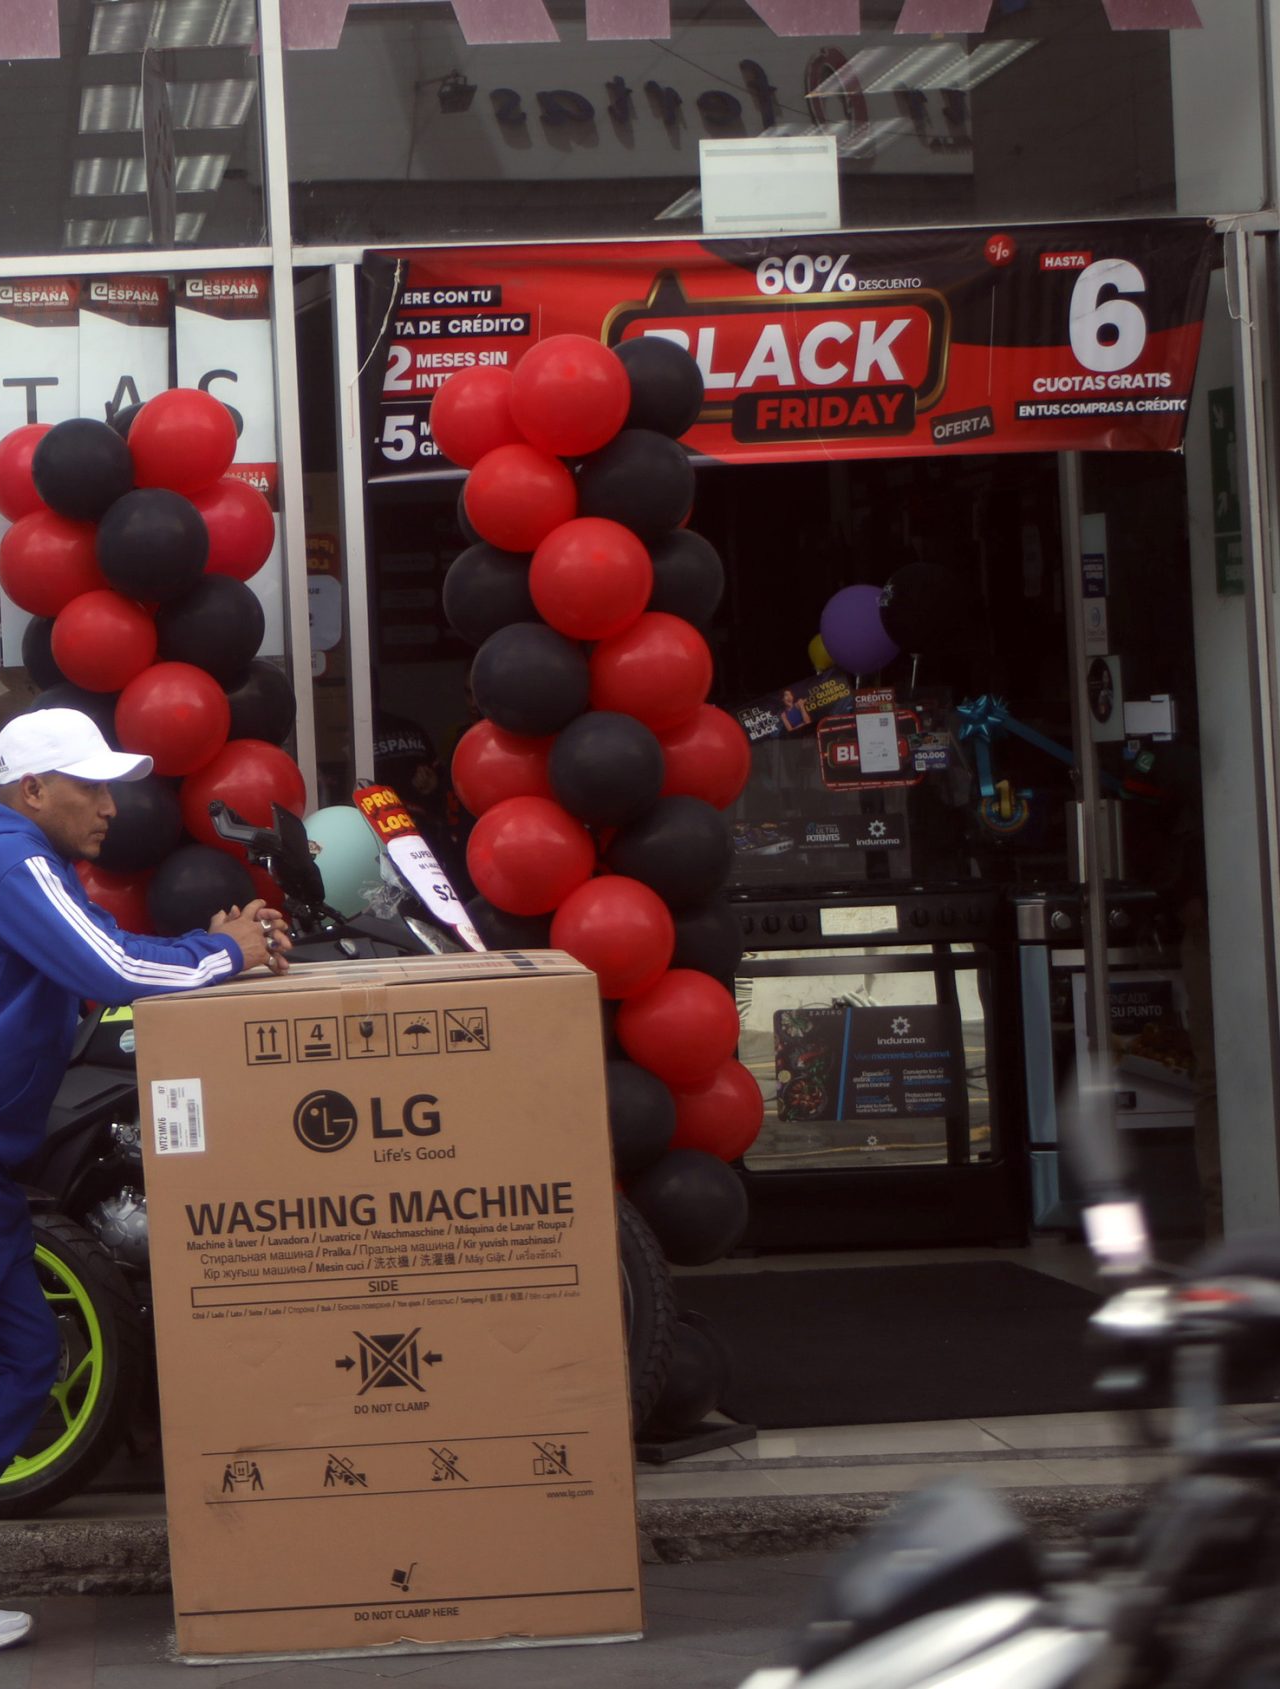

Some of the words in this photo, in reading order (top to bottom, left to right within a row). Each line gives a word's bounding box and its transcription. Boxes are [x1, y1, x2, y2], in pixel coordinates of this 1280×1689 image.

[1044, 256, 1086, 268] HASTA
[755, 254, 857, 295] 60%
[858, 278, 921, 291] DESCUENTO
[14, 290, 69, 302] ESPAÑA
[108, 288, 159, 301] ESPAÑA
[204, 284, 259, 297] ESPAÑA
[434, 290, 468, 304] CON
[471, 290, 492, 303] TU
[419, 320, 441, 334] DE
[448, 313, 525, 333] CRÉDITO
[1069, 258, 1147, 373] 6
[416, 352, 476, 368] MESES
[478, 351, 508, 366] SIN
[1033, 376, 1106, 393] CUOTAS
[1107, 373, 1172, 389] GRATIS
[756, 393, 904, 430] FRIDAY
[1019, 404, 1037, 417] EN
[1037, 403, 1061, 416] TUS
[1061, 401, 1124, 415] COMPRAS
[1124, 401, 1135, 413] A
[933, 415, 991, 439] OFERTA
[370, 1094, 441, 1139] LG
[373, 1146, 412, 1164] Life's
[415, 1145, 456, 1161] Good
[185, 1193, 377, 1237] WASHING
[389, 1181, 574, 1225] MACHINE
[187, 1239, 226, 1251] Machine
[234, 1238, 258, 1248] laver
[268, 1234, 310, 1246] Lavadora
[320, 1231, 362, 1243] Lavatrice
[371, 1227, 445, 1240] Waschmaschine
[454, 1223, 494, 1236] Máquina
[496, 1222, 509, 1233] de
[510, 1221, 536, 1232] Lavar
[537, 1219, 568, 1232] Roupa
[463, 1239, 478, 1250] Kir
[478, 1237, 509, 1250] yuvish
[510, 1234, 557, 1247] mashinasi
[322, 1246, 352, 1258] Pralka
[410, 1240, 455, 1252] машина
[200, 1252, 267, 1266] Стиральная
[269, 1249, 314, 1262] машина
[316, 1261, 344, 1273] Mesin
[345, 1261, 365, 1272] cuci
[367, 1279, 399, 1293] SIDE
[354, 1405, 370, 1415] DO
[371, 1403, 392, 1415] NOT
[394, 1401, 430, 1414] CLAMP
[546, 1487, 595, 1499] www.lg.com
[354, 1611, 370, 1621] DO
[371, 1610, 392, 1621] NOT
[394, 1608, 431, 1620] CLAMP
[433, 1606, 460, 1618] HERE
